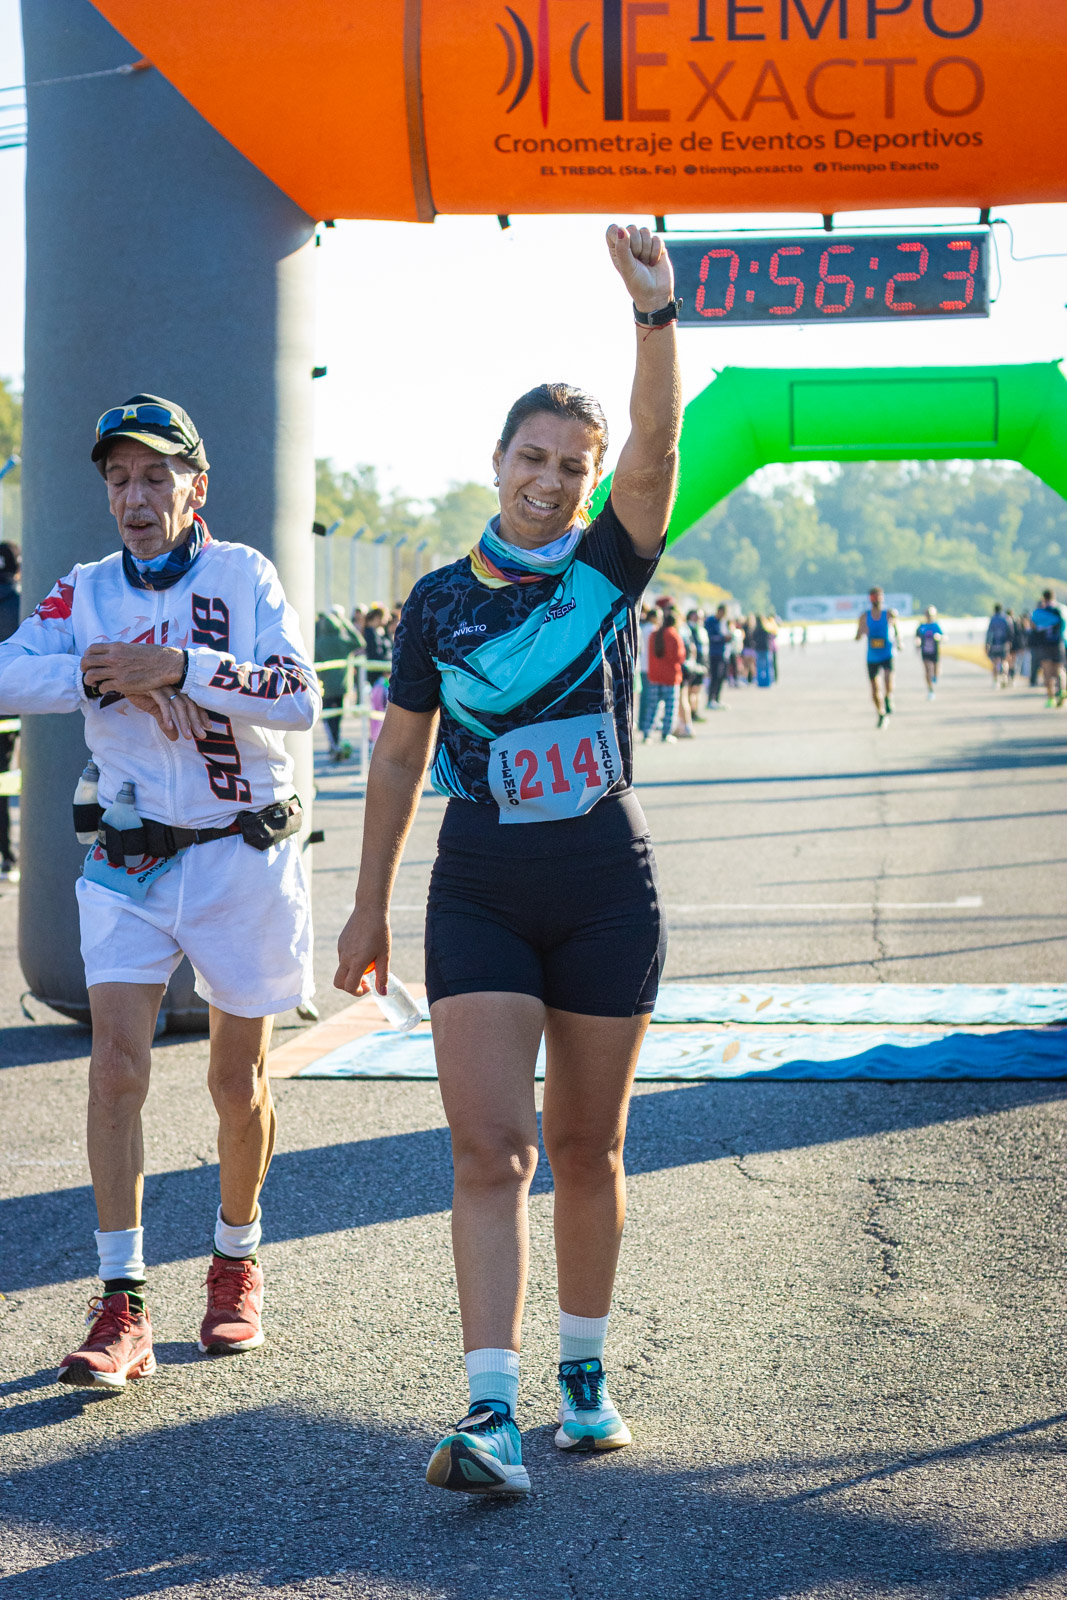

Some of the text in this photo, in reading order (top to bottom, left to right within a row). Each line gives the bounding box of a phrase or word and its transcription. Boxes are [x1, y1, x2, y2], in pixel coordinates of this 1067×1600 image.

[494, 128, 983, 156] Cronometraje de Eventos Deportivos
[541, 166, 557, 176] EL
[561, 165, 615, 176] TREBOL
[655, 165, 677, 176] Fe)
[829, 160, 940, 174] Tiempo Exacto
[695, 241, 979, 317] 0:56:23
[453, 624, 487, 638] INVICTO
[498, 750, 519, 806] TIEMPO
[514, 737, 602, 800] 214
[596, 730, 615, 788] EXACTO
